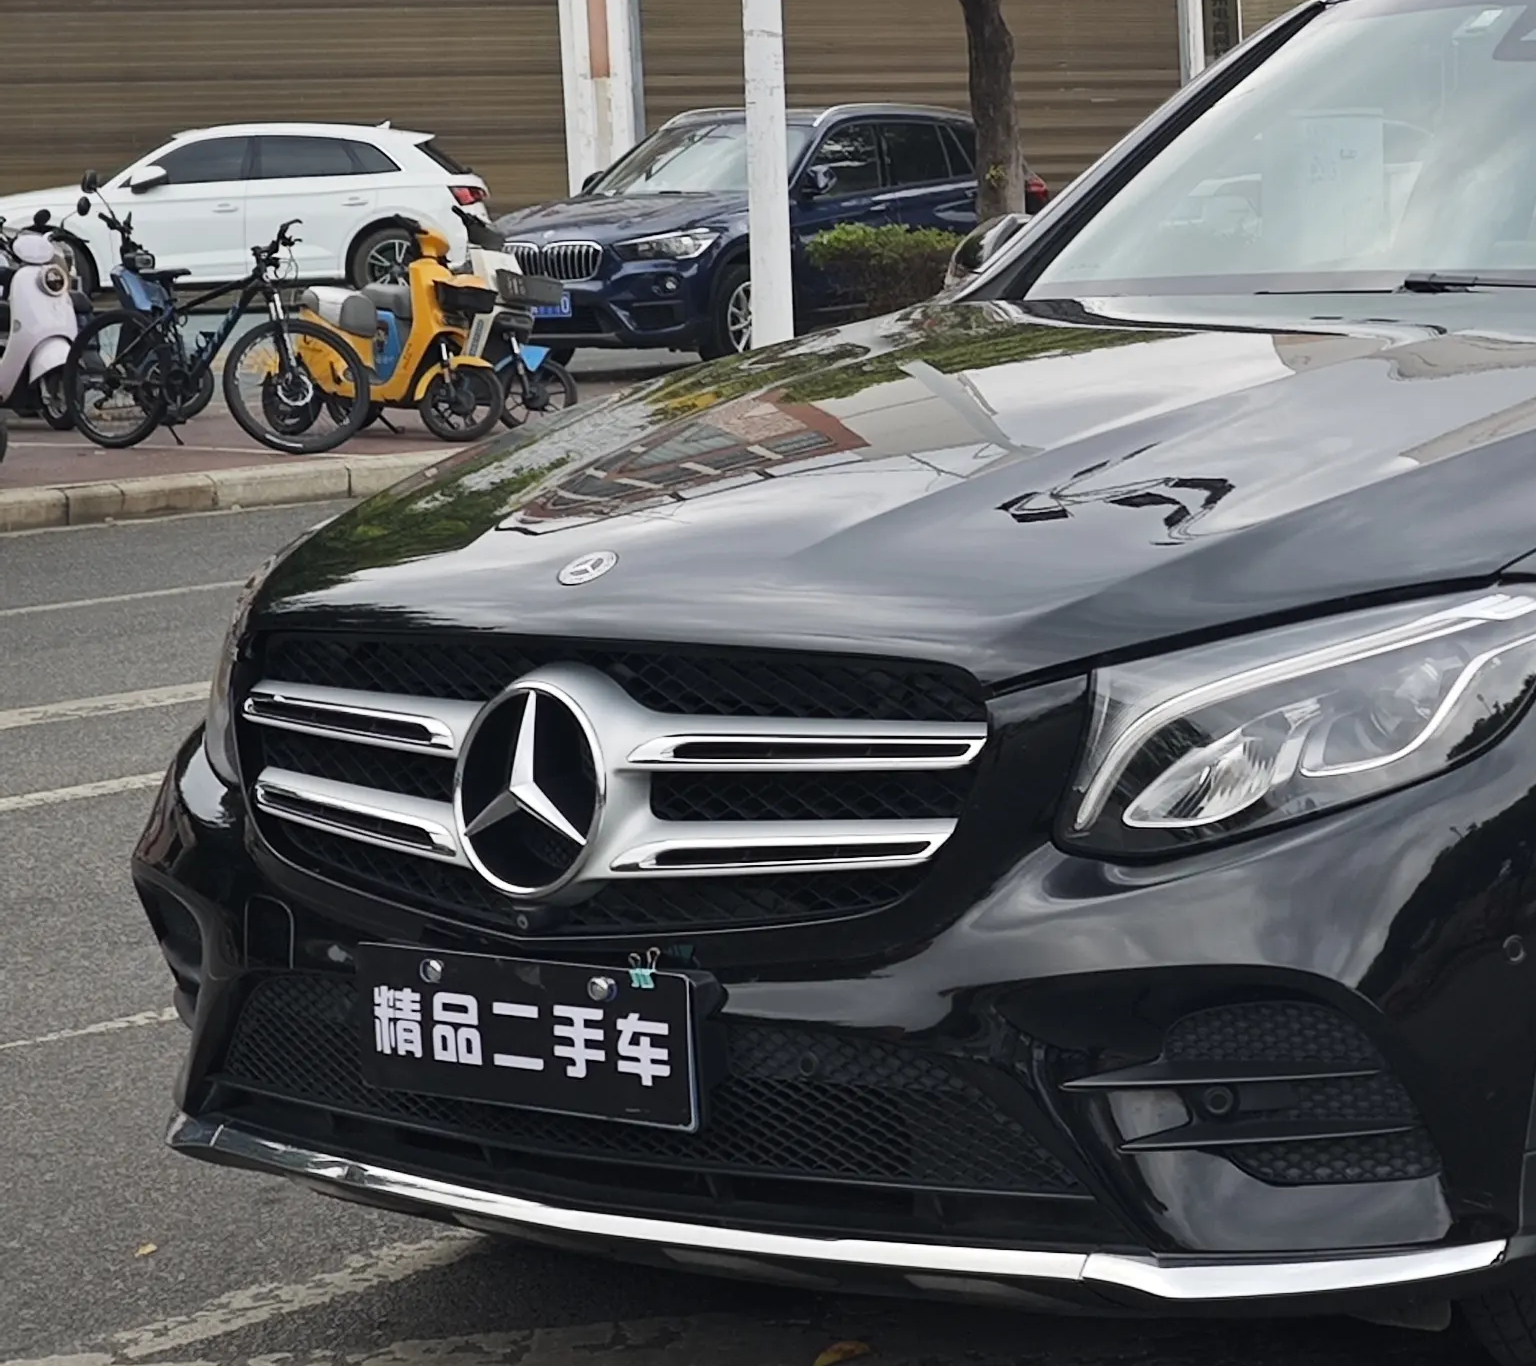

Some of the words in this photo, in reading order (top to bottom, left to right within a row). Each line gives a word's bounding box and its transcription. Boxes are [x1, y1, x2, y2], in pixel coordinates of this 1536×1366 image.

[373, 985, 671, 1087] 精品二手车
